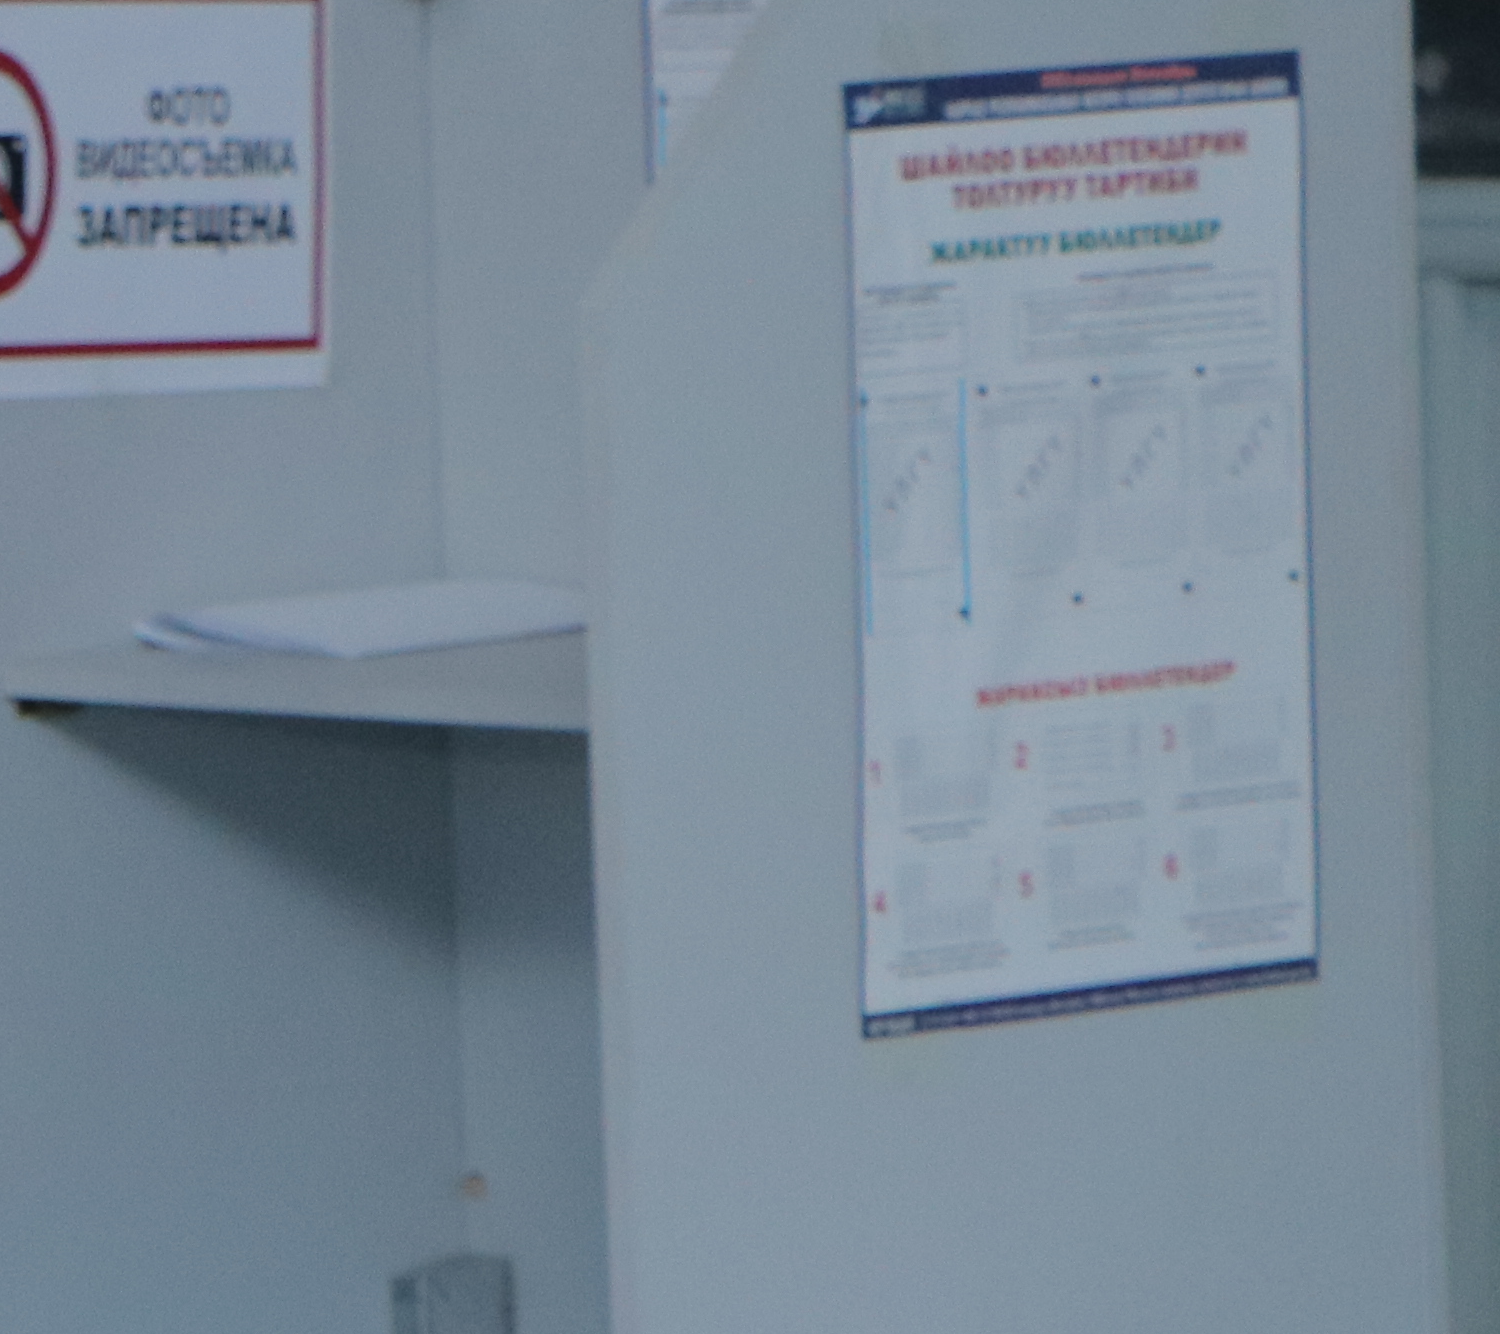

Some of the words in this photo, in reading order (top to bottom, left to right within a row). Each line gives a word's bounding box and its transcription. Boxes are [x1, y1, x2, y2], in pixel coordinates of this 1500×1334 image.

[148, 87, 231, 126] ФОТО
[76, 136, 298, 180] ВИДЕОСЪЕМКА
[78, 202, 296, 251] ЗАПРЕЩЕНА
